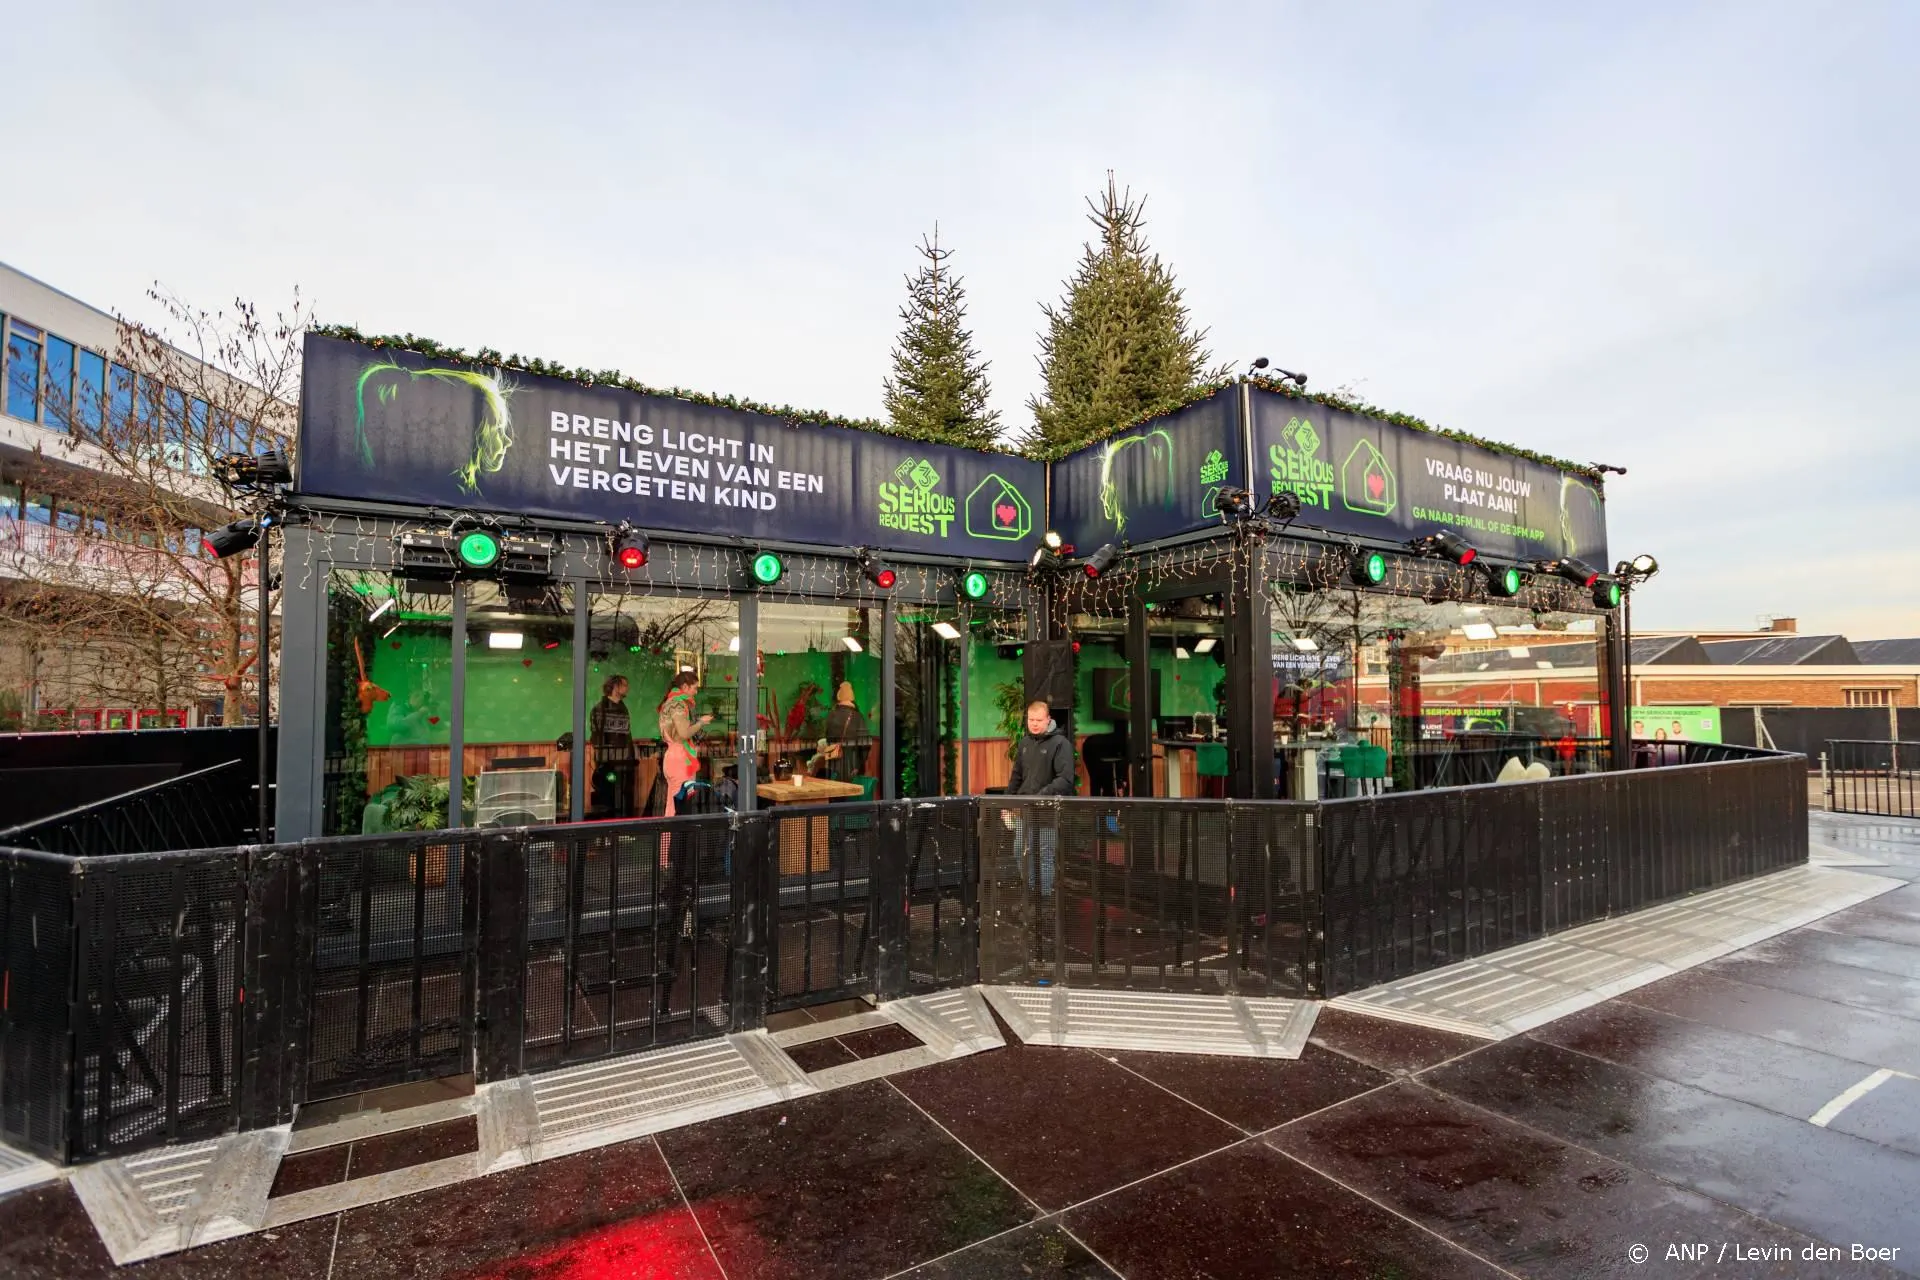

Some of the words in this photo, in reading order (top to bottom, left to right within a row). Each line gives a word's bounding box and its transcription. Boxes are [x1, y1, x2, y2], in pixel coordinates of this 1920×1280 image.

[551, 411, 653, 446] BRENG
[663, 428, 742, 459] LICHT
[750, 442, 774, 464] IN
[550, 438, 610, 465] HET
[620, 448, 709, 479] LEVEN
[716, 462, 770, 488] VAN
[778, 471, 823, 493] EEN
[1270, 444, 1334, 483] SERIOUS
[1426, 458, 1473, 483] VRAAG
[1476, 470, 1493, 489] NU
[1496, 476, 1531, 498] JOUW
[549, 464, 706, 503] VERGETEN
[715, 486, 777, 511] KIND
[879, 482, 955, 514] SERIOUS
[1444, 484, 1485, 508] PLAAT
[1488, 495, 1518, 514] AAN!
[879, 513, 954, 538] REQUEST
[1412, 506, 1427, 520] GA
[1429, 510, 1454, 525] NAAR
[1455, 515, 1486, 530] 3FM.NL
[1487, 520, 1499, 532] OF
[1500, 523, 1512, 535] DE
[1512, 525, 1528, 538] 3FM
[1529, 528, 1545, 540] APP
